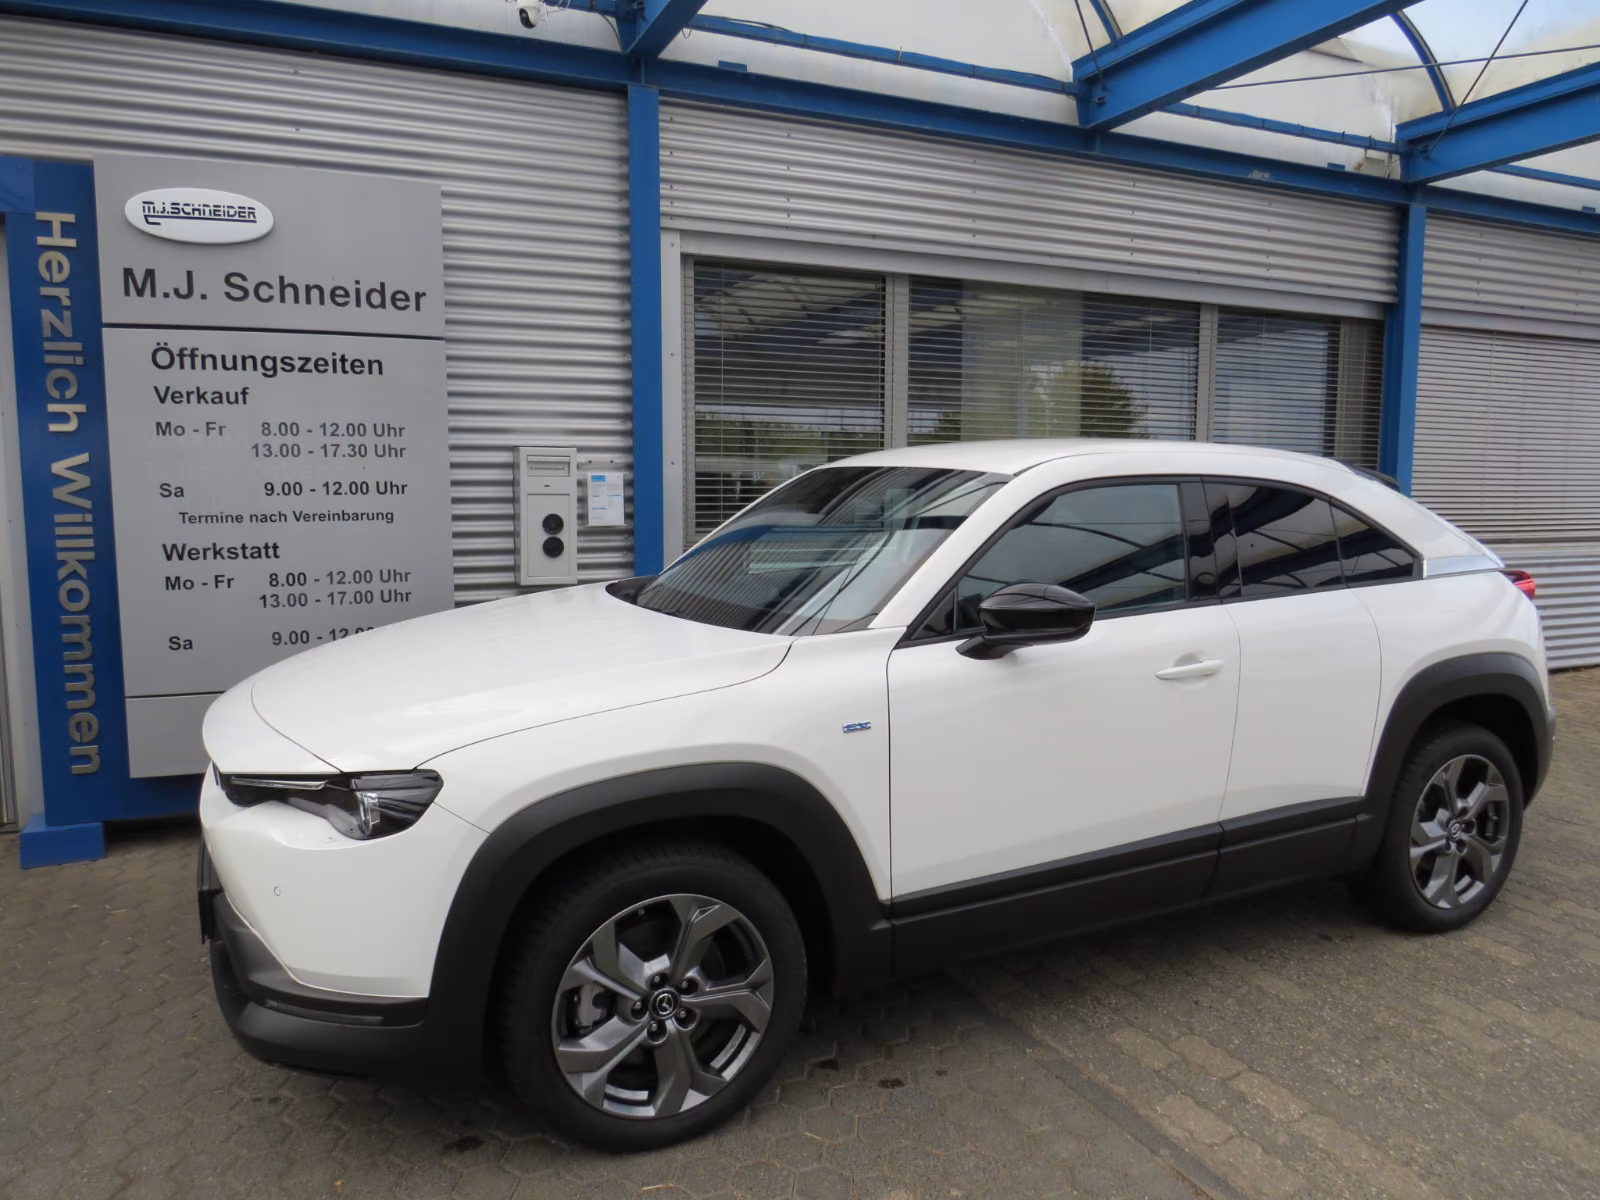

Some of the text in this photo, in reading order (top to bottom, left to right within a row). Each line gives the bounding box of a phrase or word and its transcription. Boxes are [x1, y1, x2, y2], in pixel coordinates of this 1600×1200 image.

[122, 266, 427, 313] M.J. Schneider
[150, 341, 384, 378] Öffnungszeiten
[152, 385, 250, 406] Verkauf
[155, 420, 186, 437] Mo
[205, 421, 227, 437] Fr
[261, 421, 300, 437] 8.00
[319, 421, 367, 438] 12.00
[372, 422, 406, 438] Uhr
[250, 442, 302, 459] 13.00
[319, 443, 368, 459] 17.30
[373, 443, 407, 459] Uhr
[35, 211, 101, 774] Herzlich Willkommen
[159, 482, 185, 499] Sa
[263, 481, 304, 497] 9.00
[321, 480, 370, 496] 12.00
[375, 480, 409, 496] Uhr
[178, 509, 395, 525] Termine nach Vereinbarung
[161, 541, 281, 562] Werkstatt
[164, 575, 195, 592] Mo
[213, 574, 235, 590] Fr
[268, 571, 308, 588] 8.00
[325, 569, 374, 586] 12.00
[379, 568, 412, 584] Uhr
[258, 592, 309, 609] 13.00
[327, 589, 374, 606] 17.00
[380, 588, 412, 604] Uhr
[168, 635, 194, 651] Sa
[271, 629, 311, 646] 9.00
